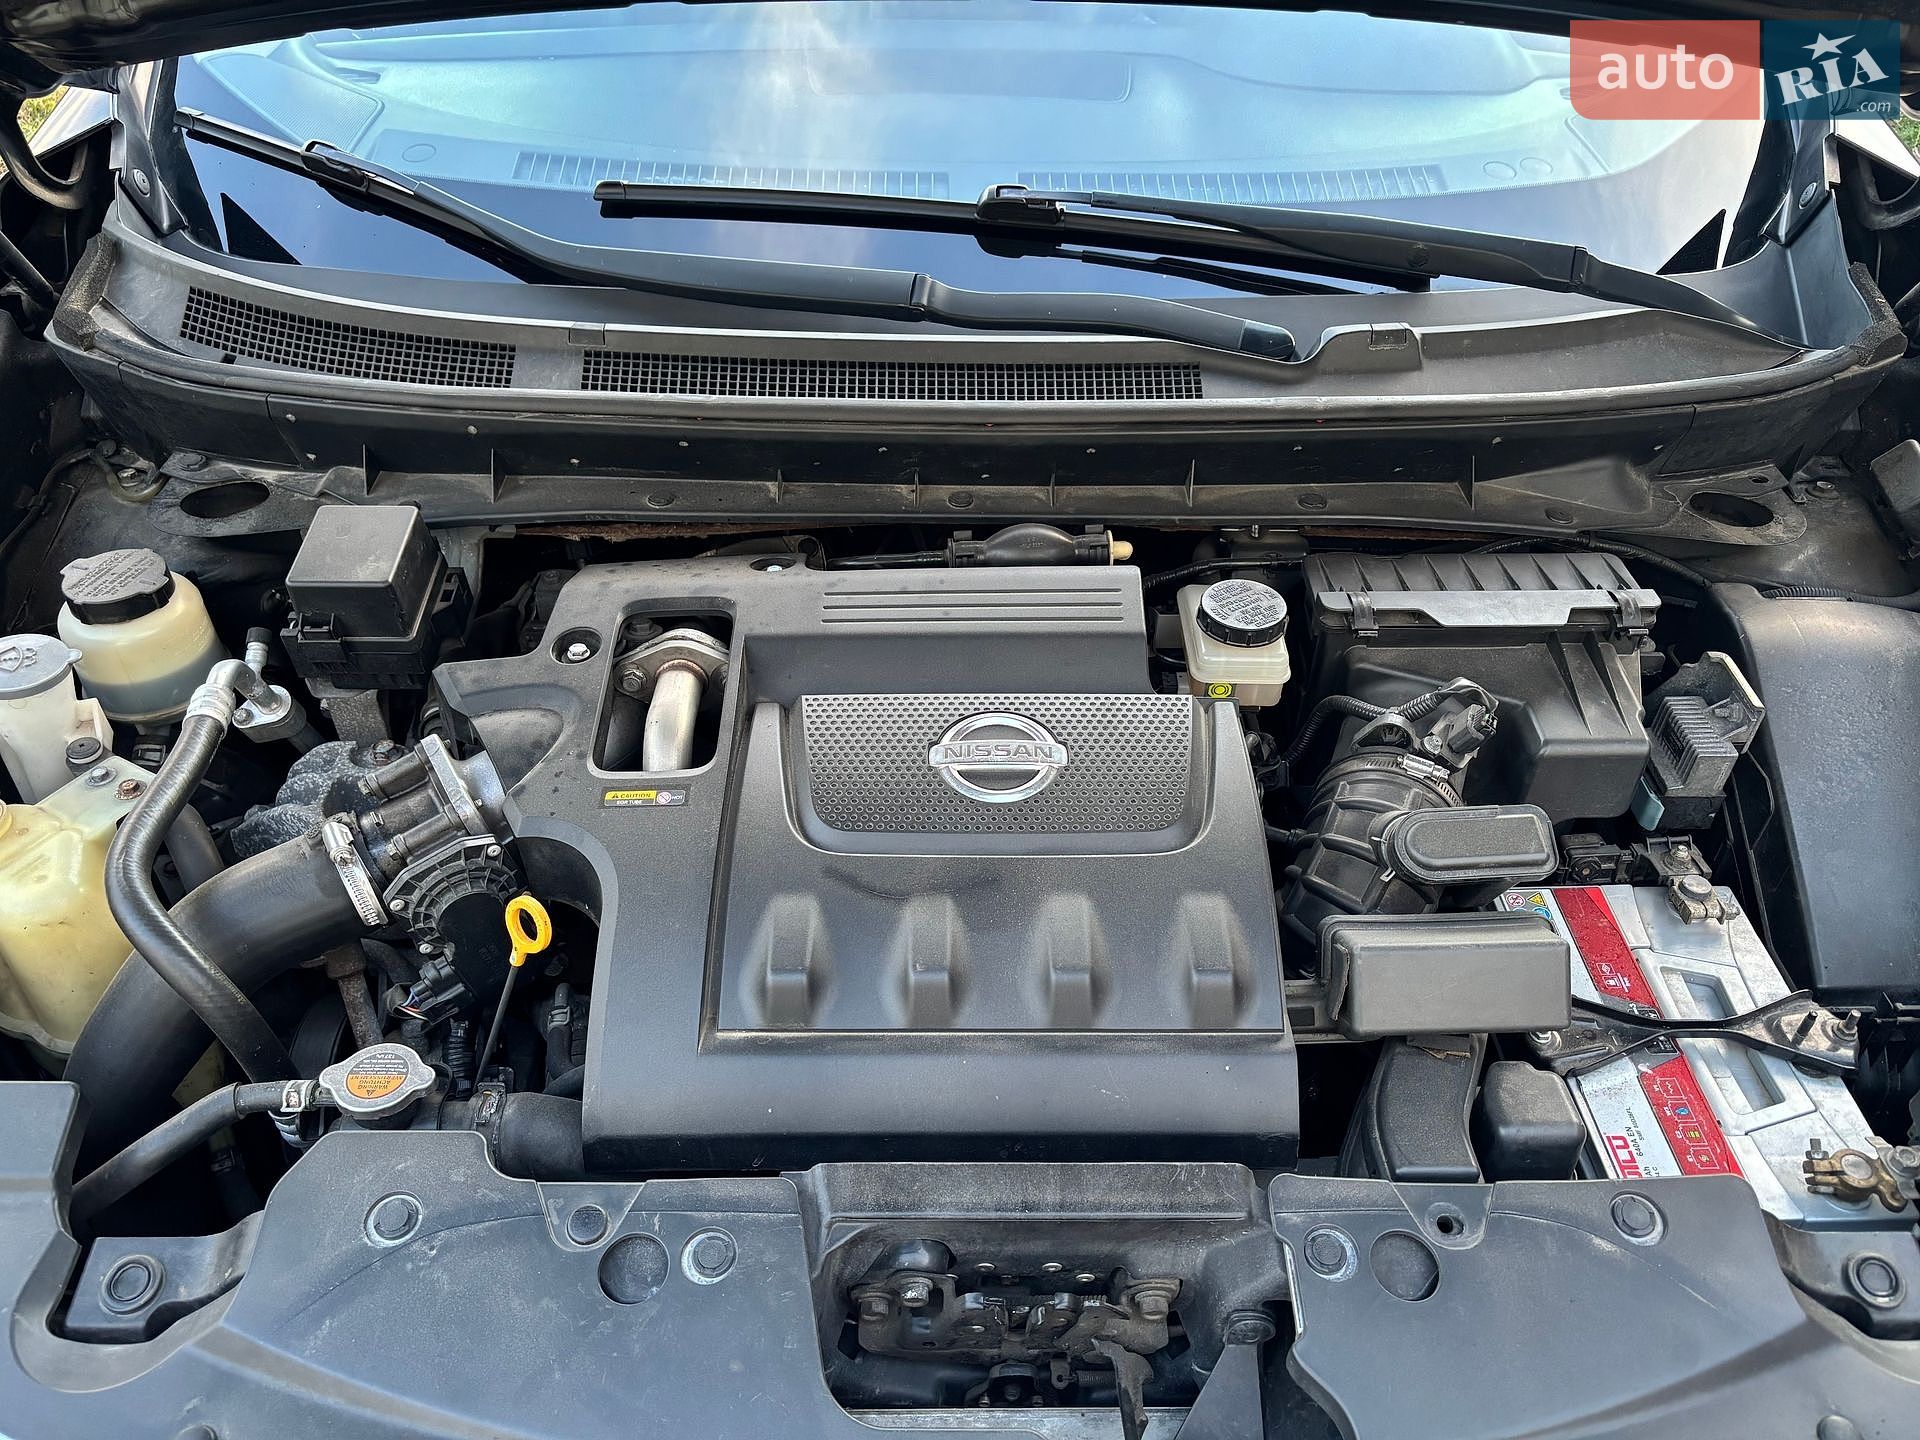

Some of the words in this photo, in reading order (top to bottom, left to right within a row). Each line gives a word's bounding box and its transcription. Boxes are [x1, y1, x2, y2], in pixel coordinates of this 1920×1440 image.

[944, 744, 1053, 760] NISSAN
[1625, 1127, 1635, 1138] EN
[1632, 1138, 1644, 1157] 640A
